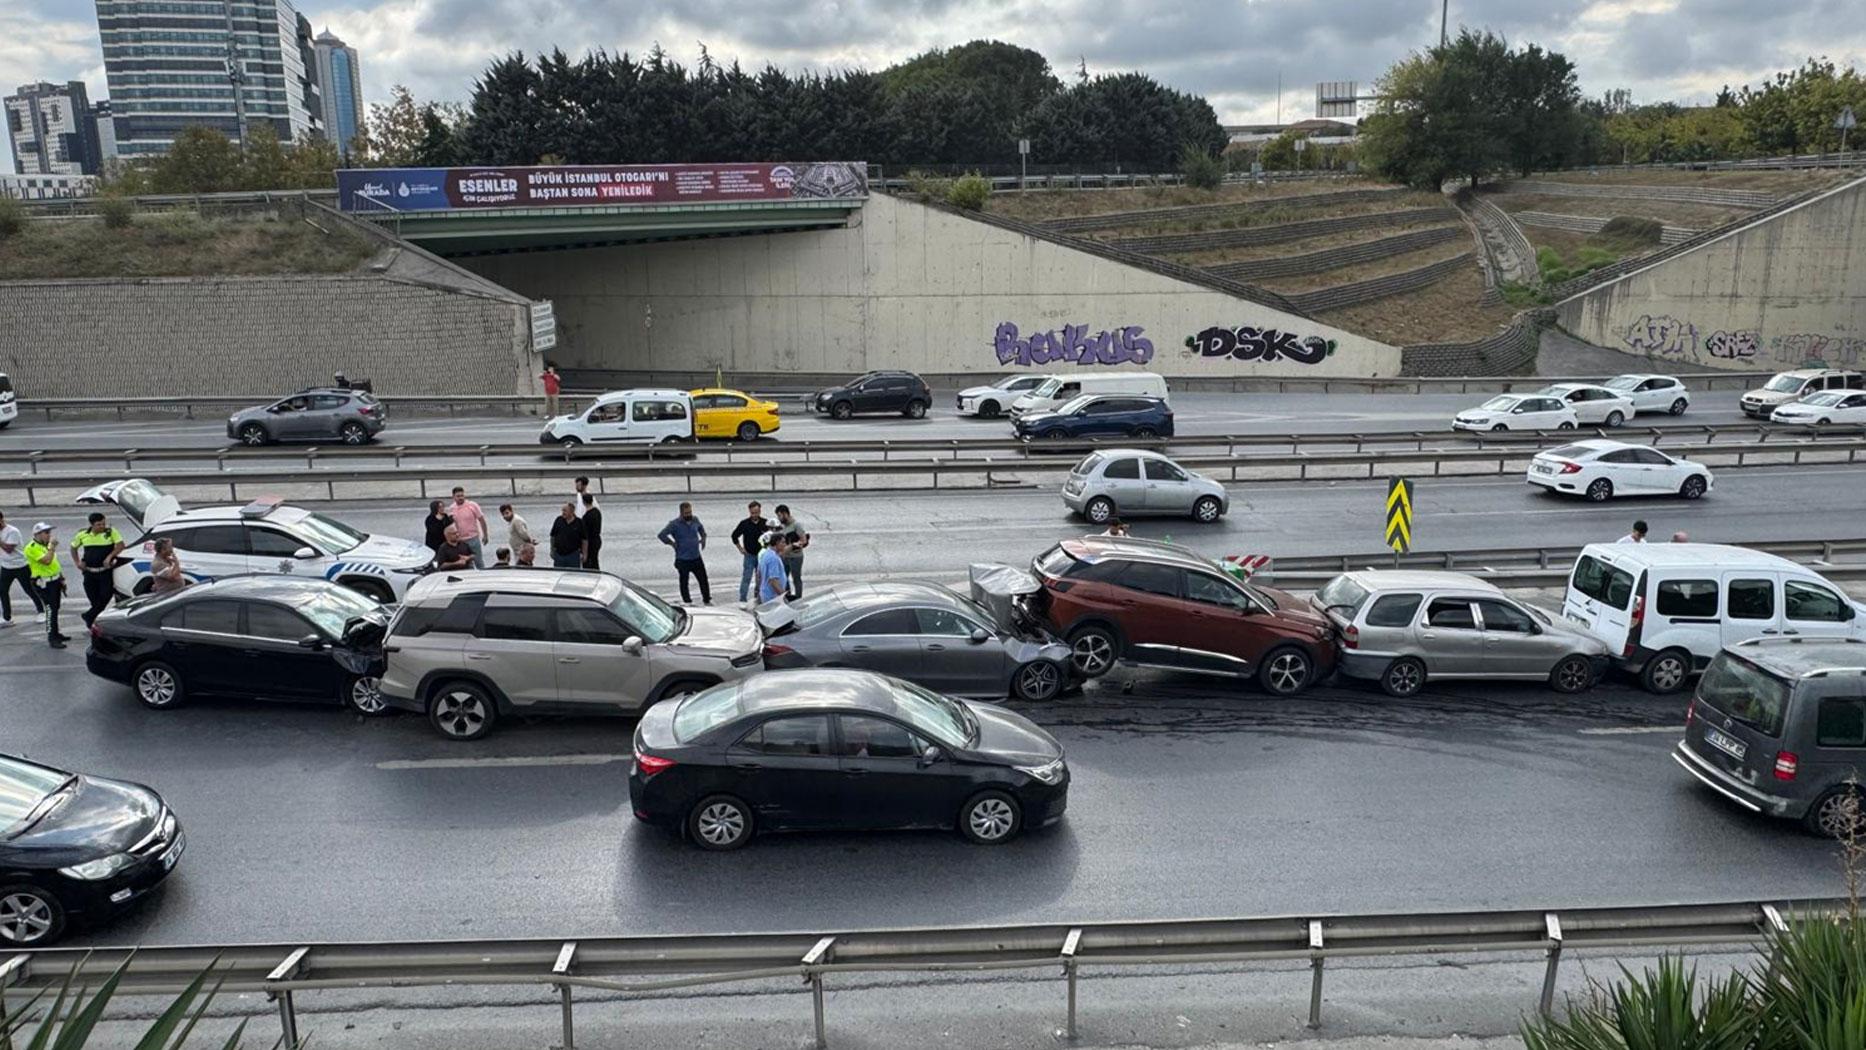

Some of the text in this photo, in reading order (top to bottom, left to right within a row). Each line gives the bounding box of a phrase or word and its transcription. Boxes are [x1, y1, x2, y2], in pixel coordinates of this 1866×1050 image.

[528, 172, 562, 184] BÜYÜK
[565, 171, 613, 184] İSTANBUL
[614, 171, 669, 183] OTOGARI'NI
[458, 179, 518, 193] ESENLER
[529, 184, 652, 200] BAŞTAN SONA YENİLEDİK
